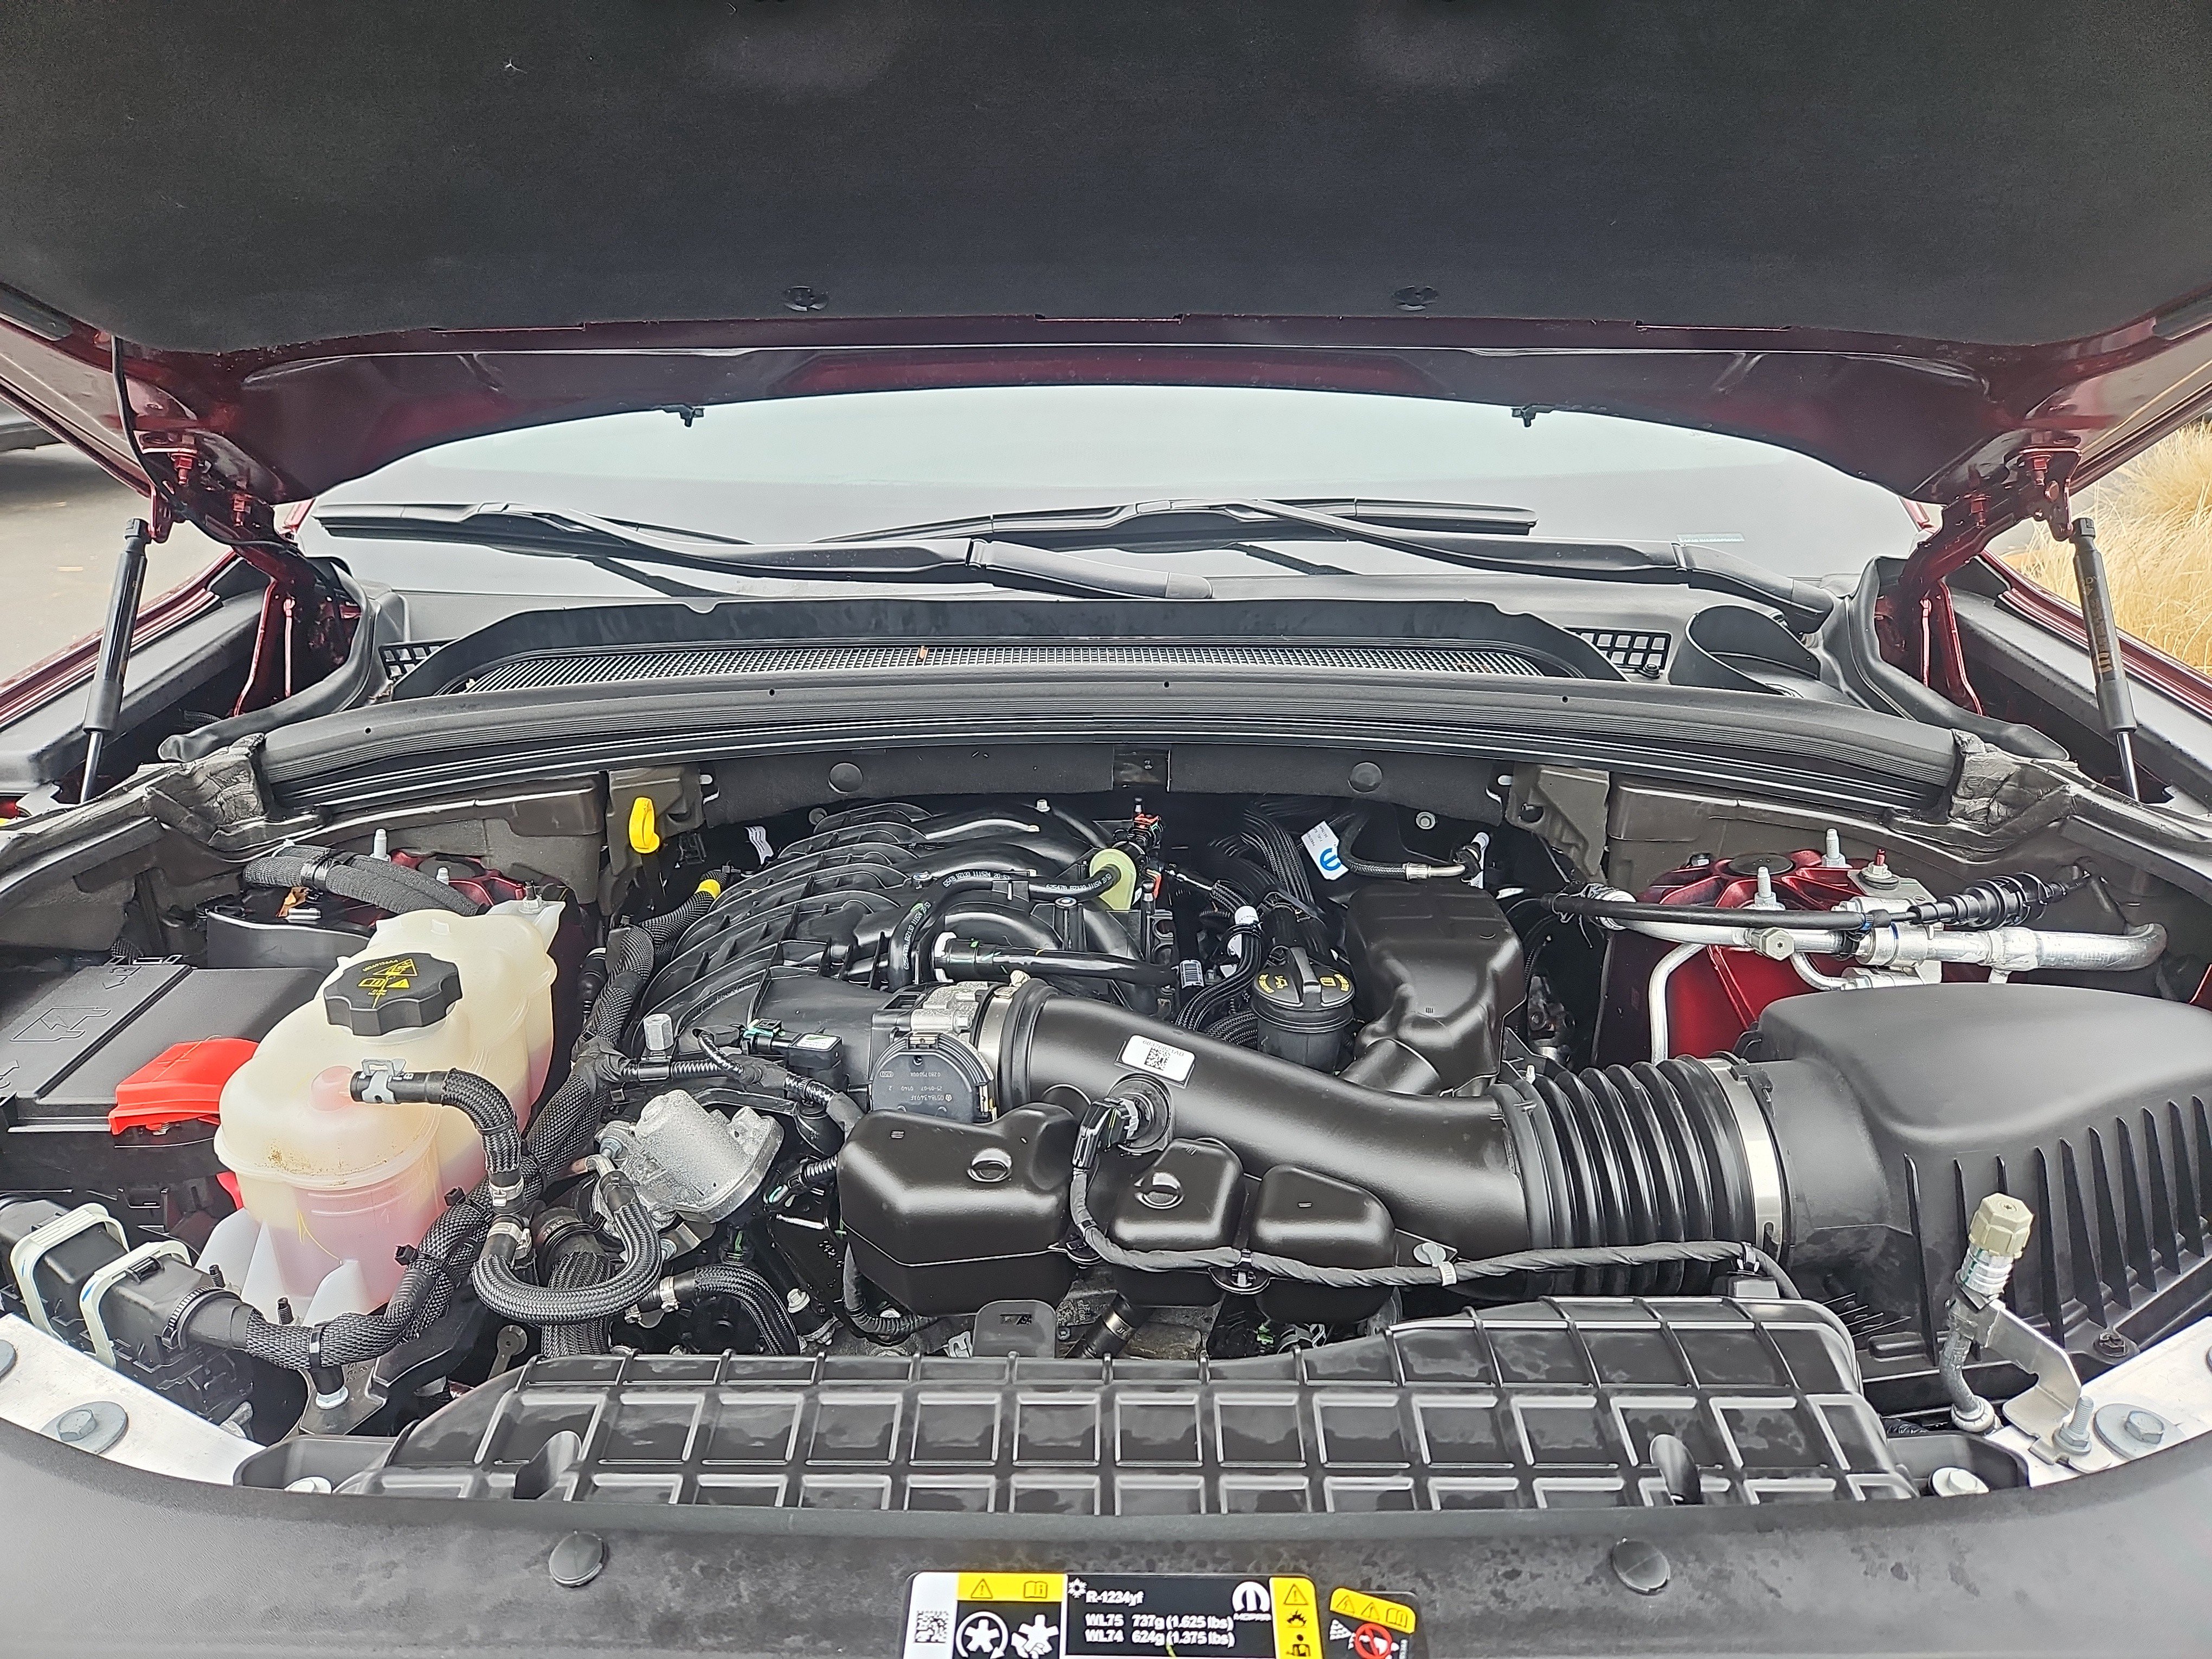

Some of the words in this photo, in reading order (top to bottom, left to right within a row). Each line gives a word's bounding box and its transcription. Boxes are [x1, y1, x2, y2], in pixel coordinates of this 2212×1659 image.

[1142, 1040, 1185, 1057] 68376821AB
[1085, 1590, 1145, 1606] R-1234yf
[1085, 1613, 1124, 1626] WL75
[1131, 1615, 1166, 1630] 737g
[1166, 1615, 1207, 1630] (1.625
[1207, 1615, 1234, 1631] lbs)
[1085, 1629, 1124, 1643] WL74
[1131, 1631, 1166, 1647] 624g
[1166, 1631, 1207, 1647] (1.375
[1208, 1631, 1236, 1649] lbs)
